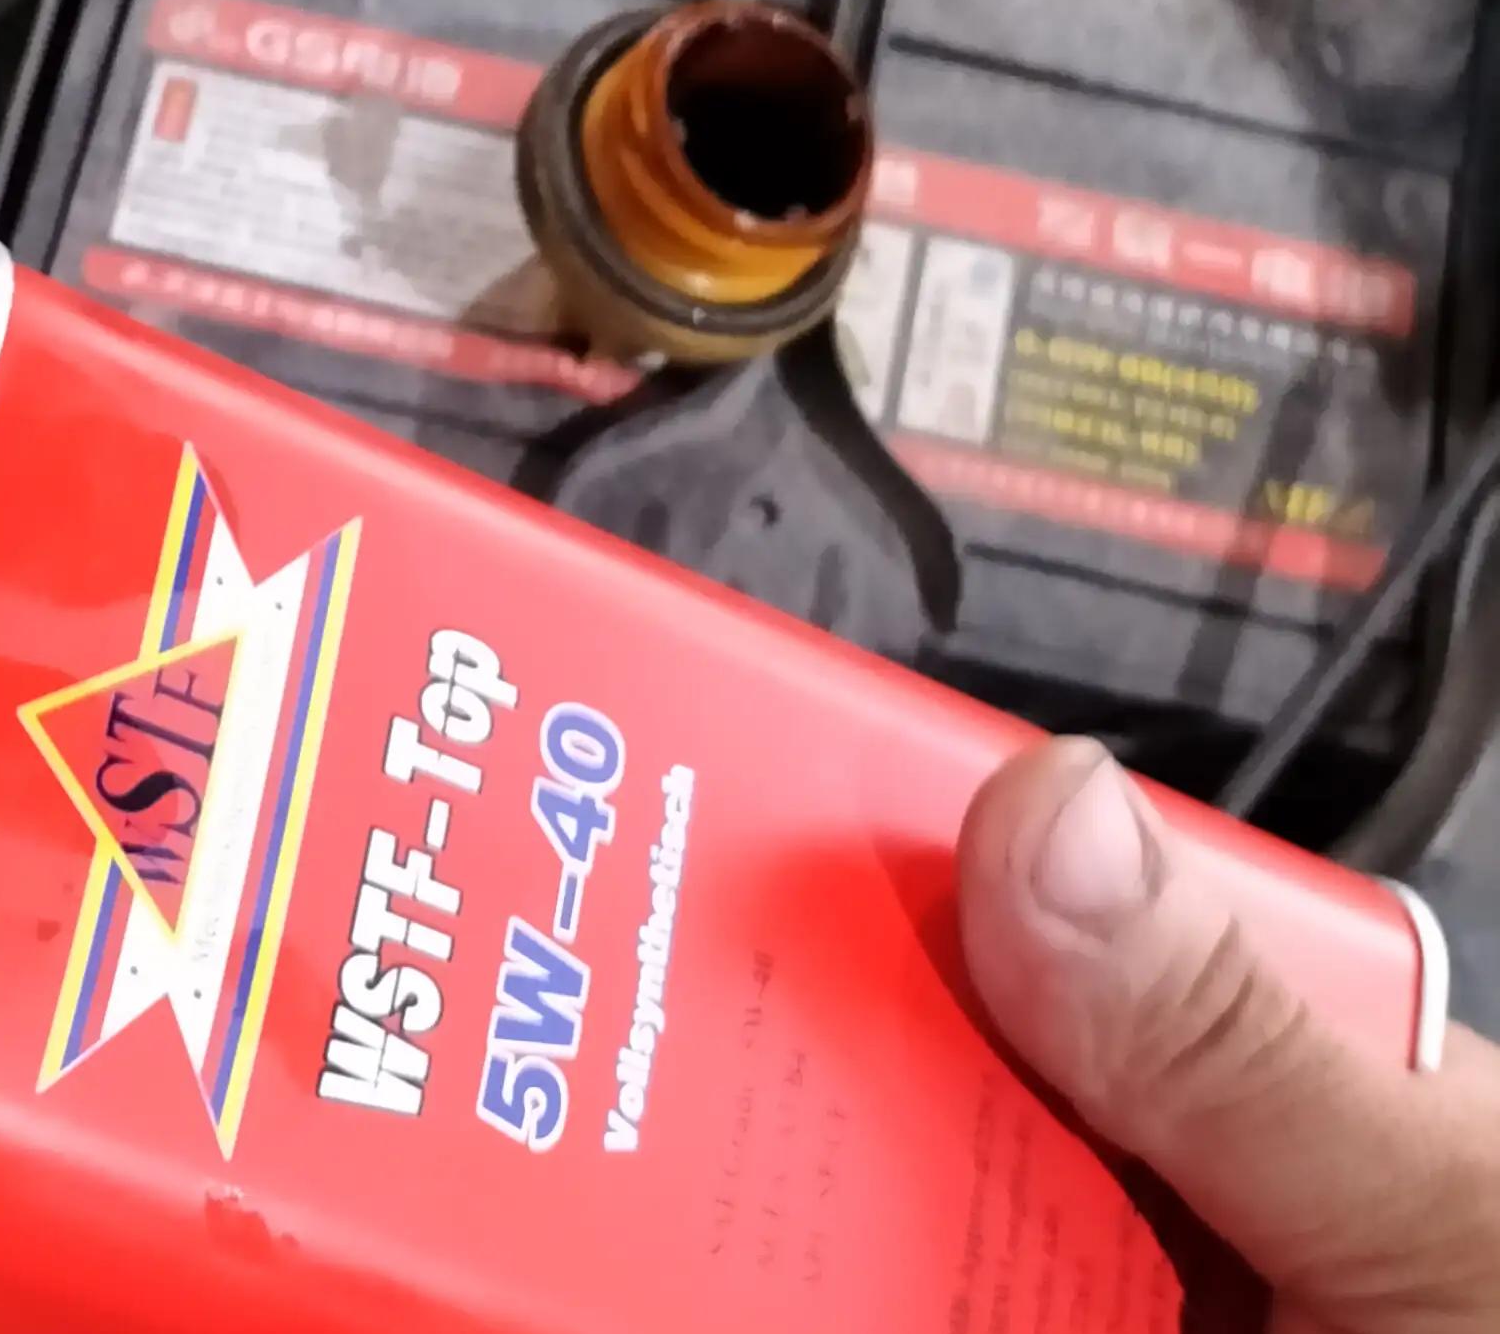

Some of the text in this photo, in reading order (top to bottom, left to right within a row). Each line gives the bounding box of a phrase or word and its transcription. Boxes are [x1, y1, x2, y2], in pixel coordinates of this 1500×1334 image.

[317, 629, 518, 1115] WSTF-Top
[476, 701, 625, 1153] 5W-40
[603, 763, 696, 1153] Vollsynthetisch
